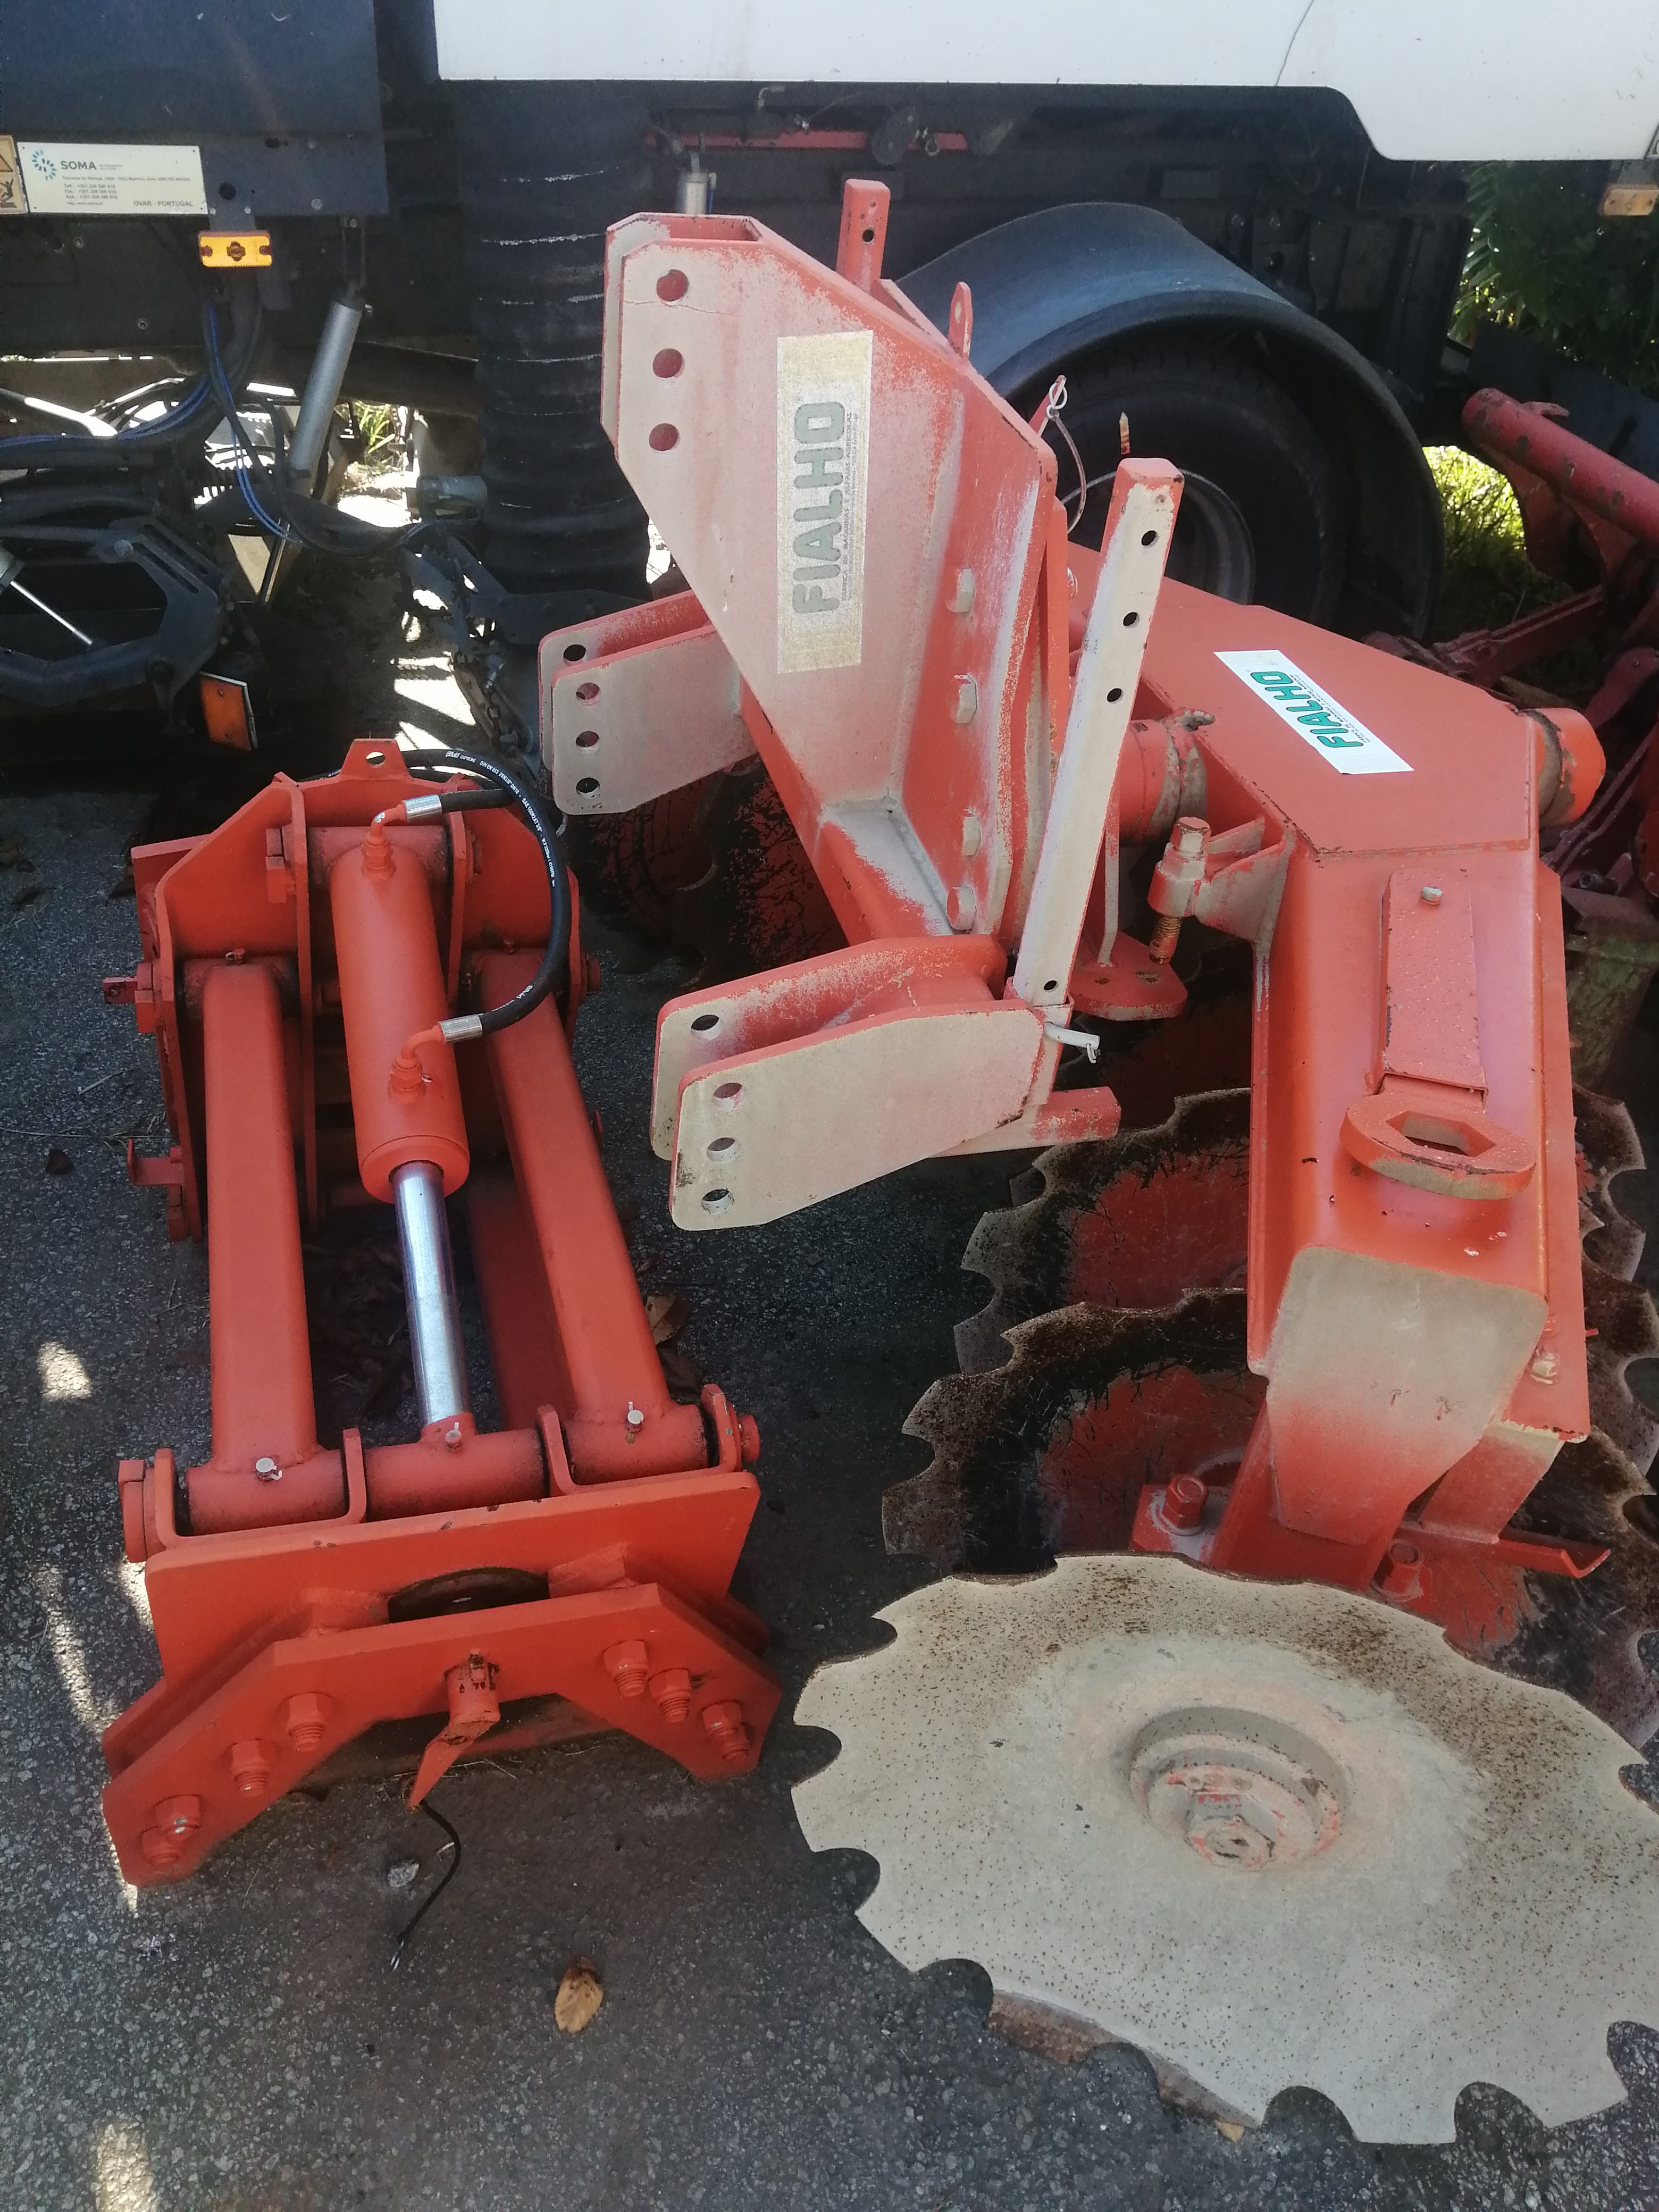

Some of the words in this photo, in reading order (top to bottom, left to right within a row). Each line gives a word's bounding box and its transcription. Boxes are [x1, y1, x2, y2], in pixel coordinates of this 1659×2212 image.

[61, 161, 97, 170] SOMA
[792, 401, 845, 615] FIALHO
[1250, 671, 1364, 748] FIALHO
